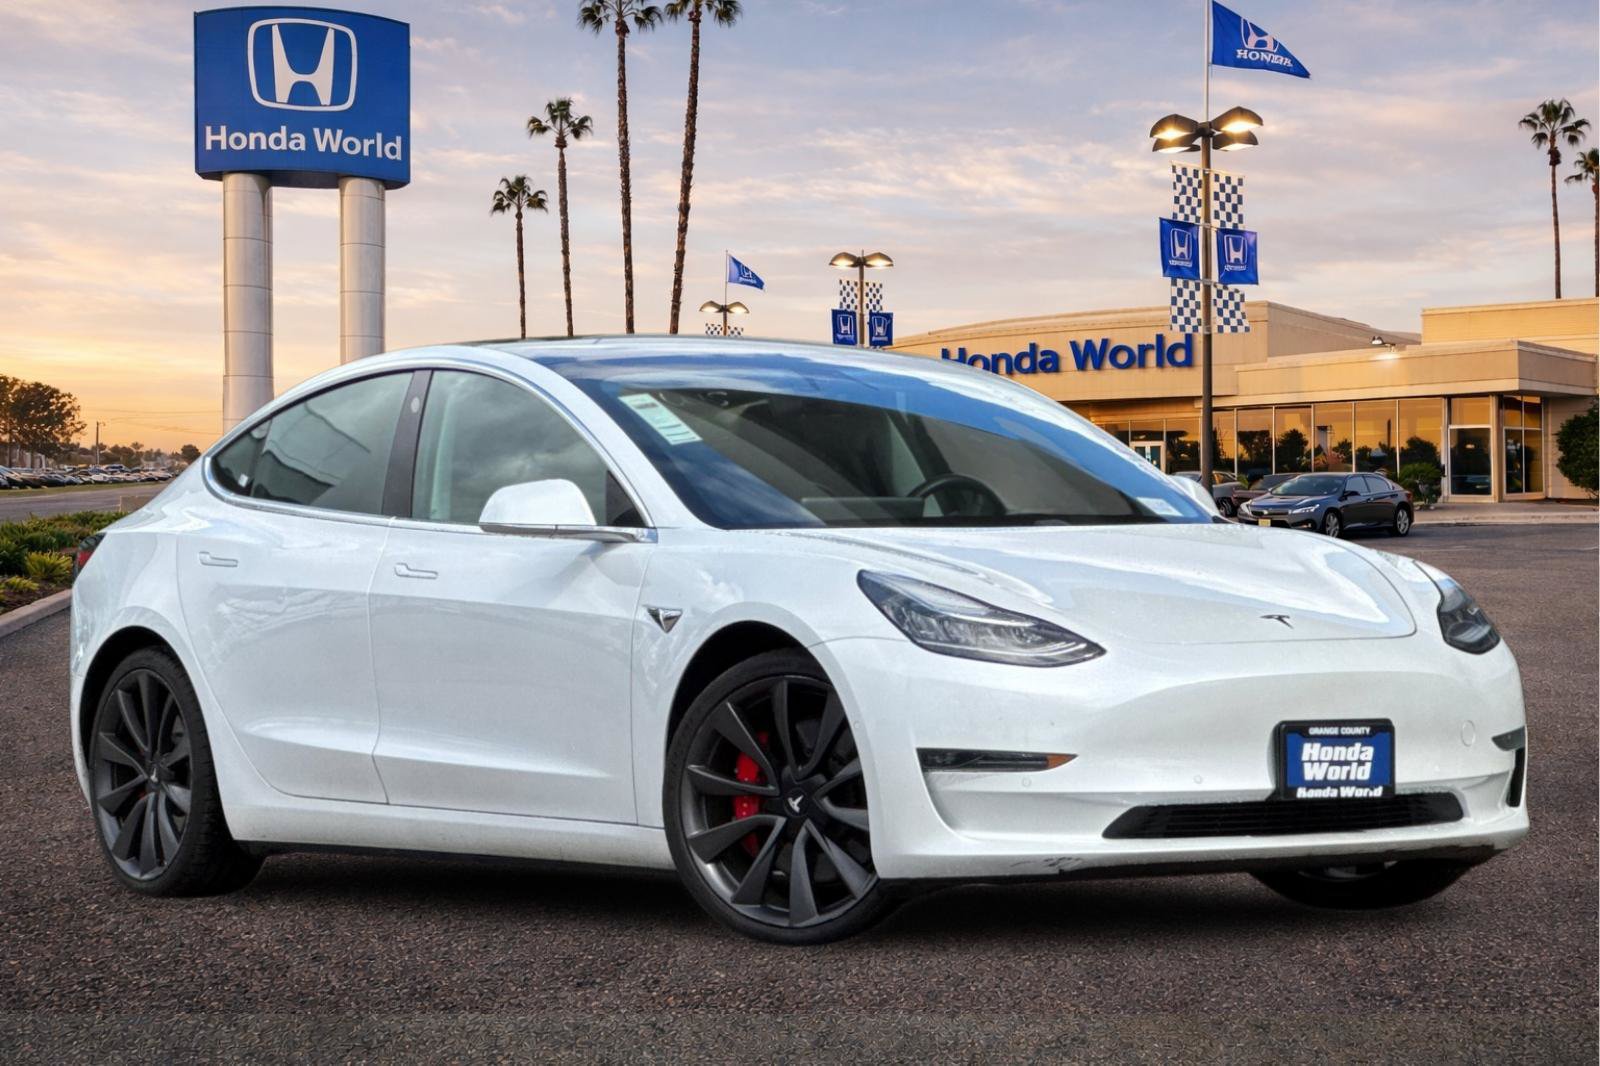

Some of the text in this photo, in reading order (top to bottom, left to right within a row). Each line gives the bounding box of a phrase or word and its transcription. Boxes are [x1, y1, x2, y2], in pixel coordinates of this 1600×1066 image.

[205, 126, 402, 160] Honda World
[1069, 333, 1194, 371] World
[1340, 727, 1371, 735] COUNTY
[1301, 742, 1374, 761] Honda
[1303, 761, 1372, 781] World
[1296, 786, 1338, 798] Honda
